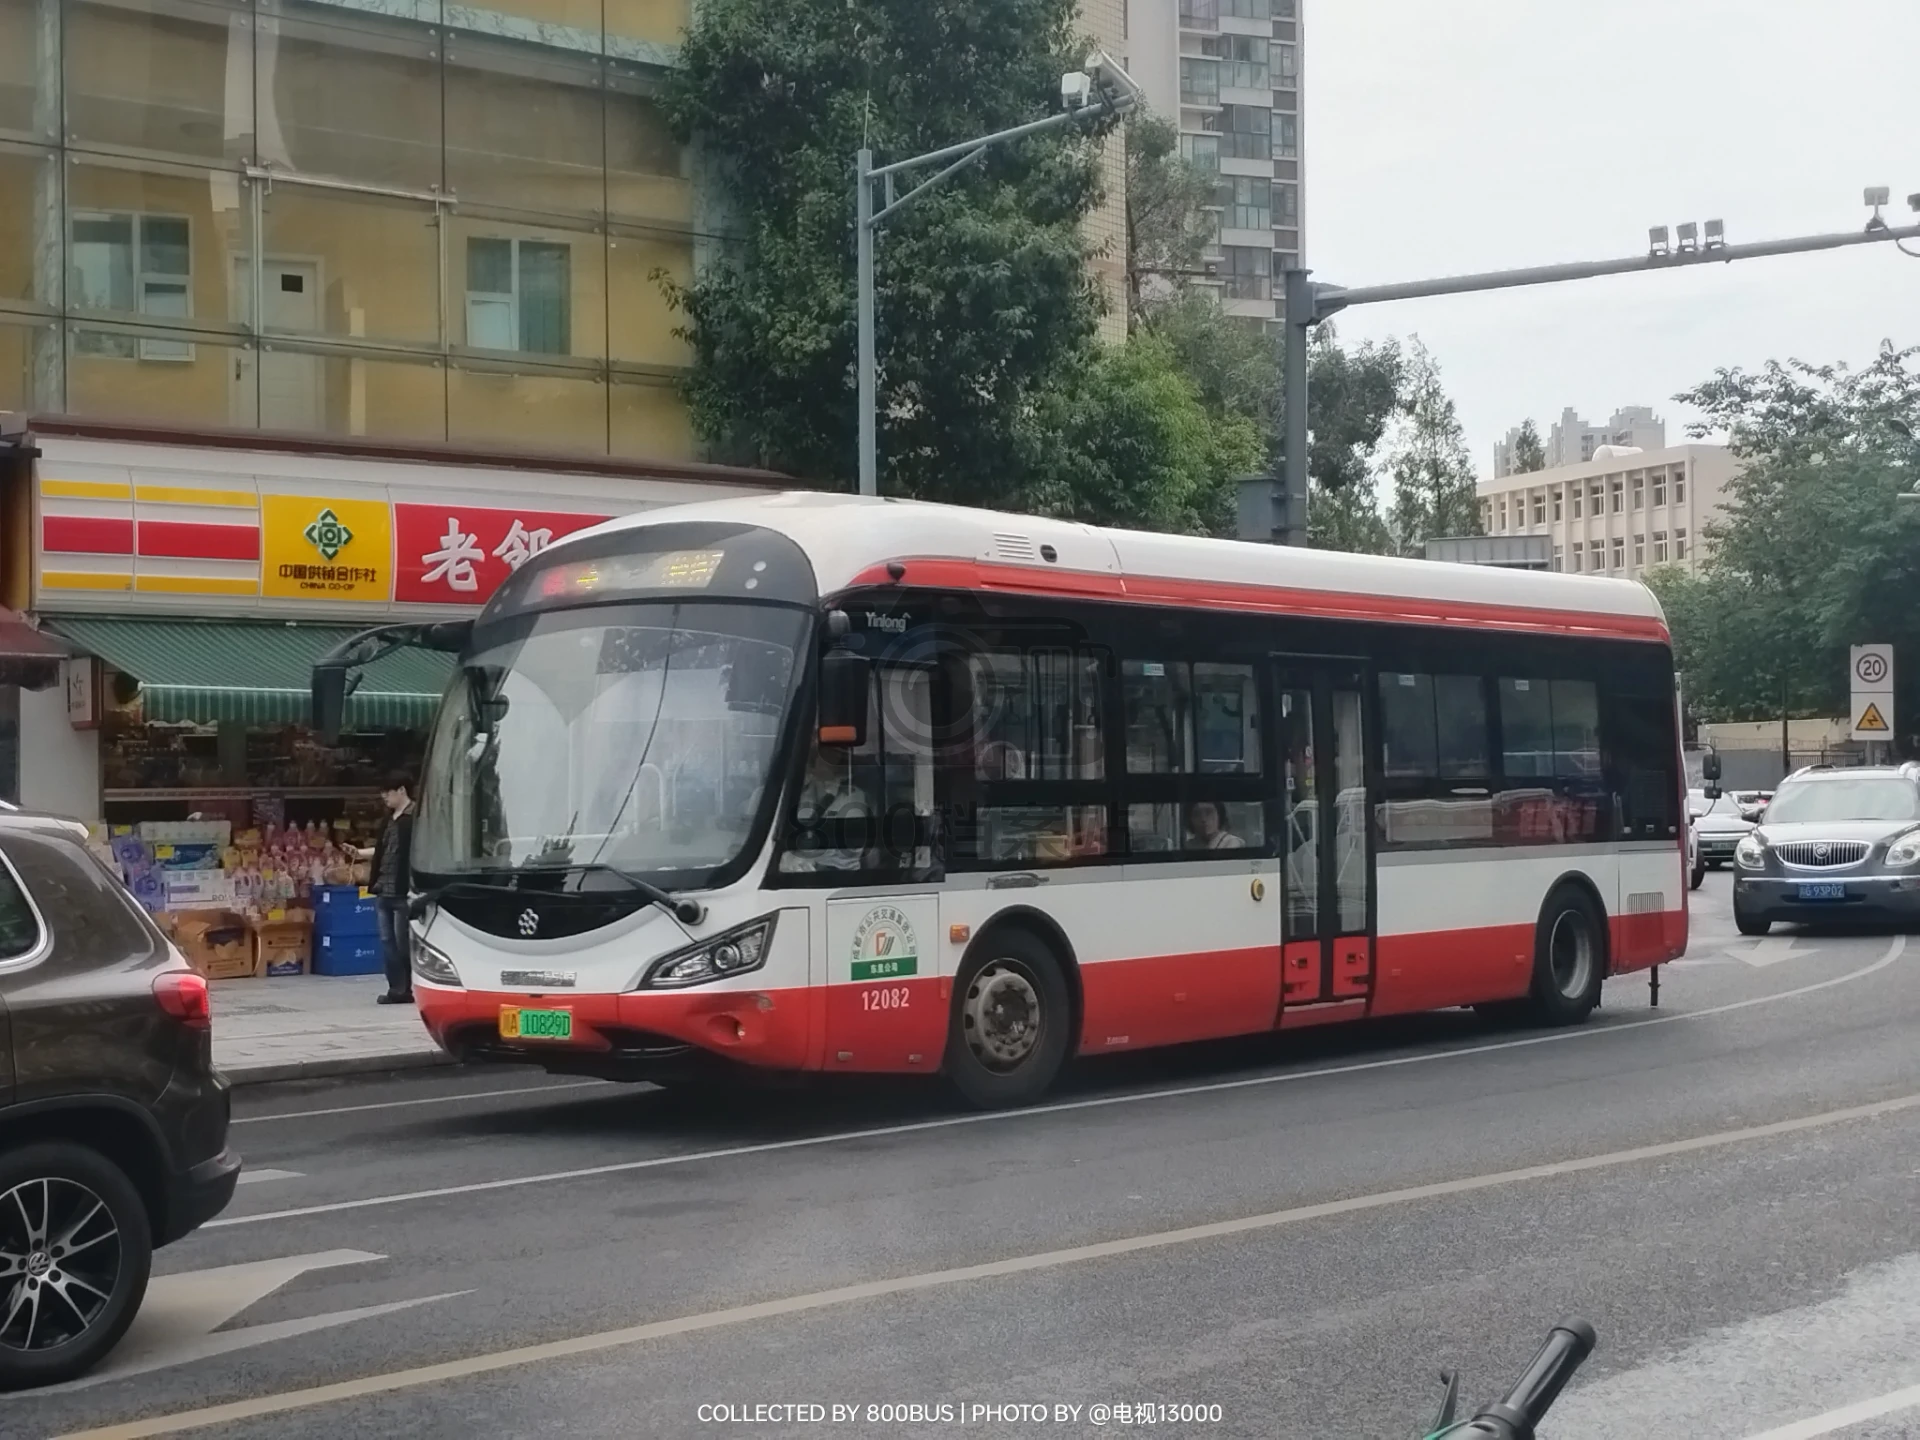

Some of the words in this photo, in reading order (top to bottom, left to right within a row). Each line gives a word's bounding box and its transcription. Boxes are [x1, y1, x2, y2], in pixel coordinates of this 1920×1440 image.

[279, 564, 377, 583] 中国供销合作社
[300, 582, 326, 590] CHINA
[865, 611, 907, 633] Yinlong
[1863, 660, 1882, 677] 20
[862, 987, 910, 1011] 12082
